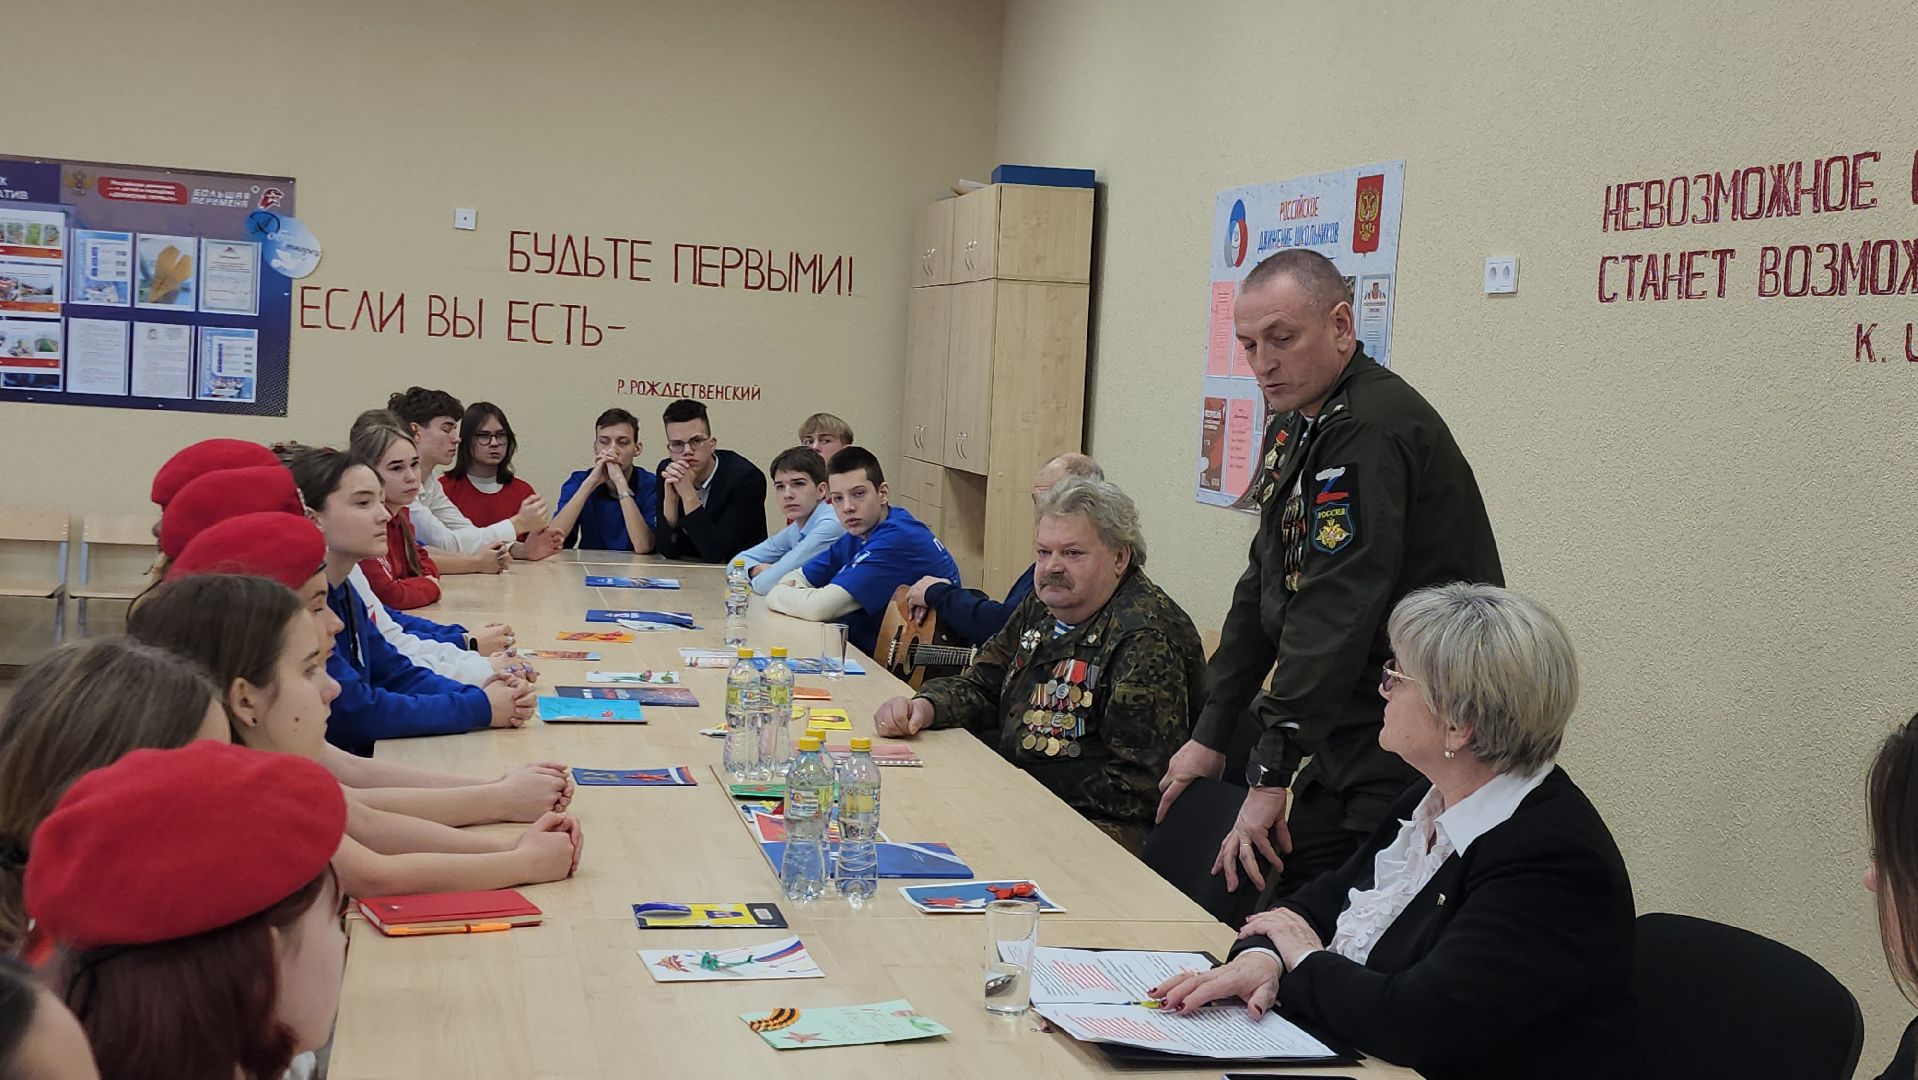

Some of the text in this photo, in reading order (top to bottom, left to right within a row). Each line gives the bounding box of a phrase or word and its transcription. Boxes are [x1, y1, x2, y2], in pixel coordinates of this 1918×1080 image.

[1602, 151, 1881, 233] НЕВОЗМОЖНОЕ
[509, 230, 855, 297] БУДЬТЕ ПЕРВЫМИ!
[1598, 248, 1736, 303] СТАНЕТ
[300, 286, 404, 334] ЕСЛИ
[427, 295, 483, 340] ВЫ
